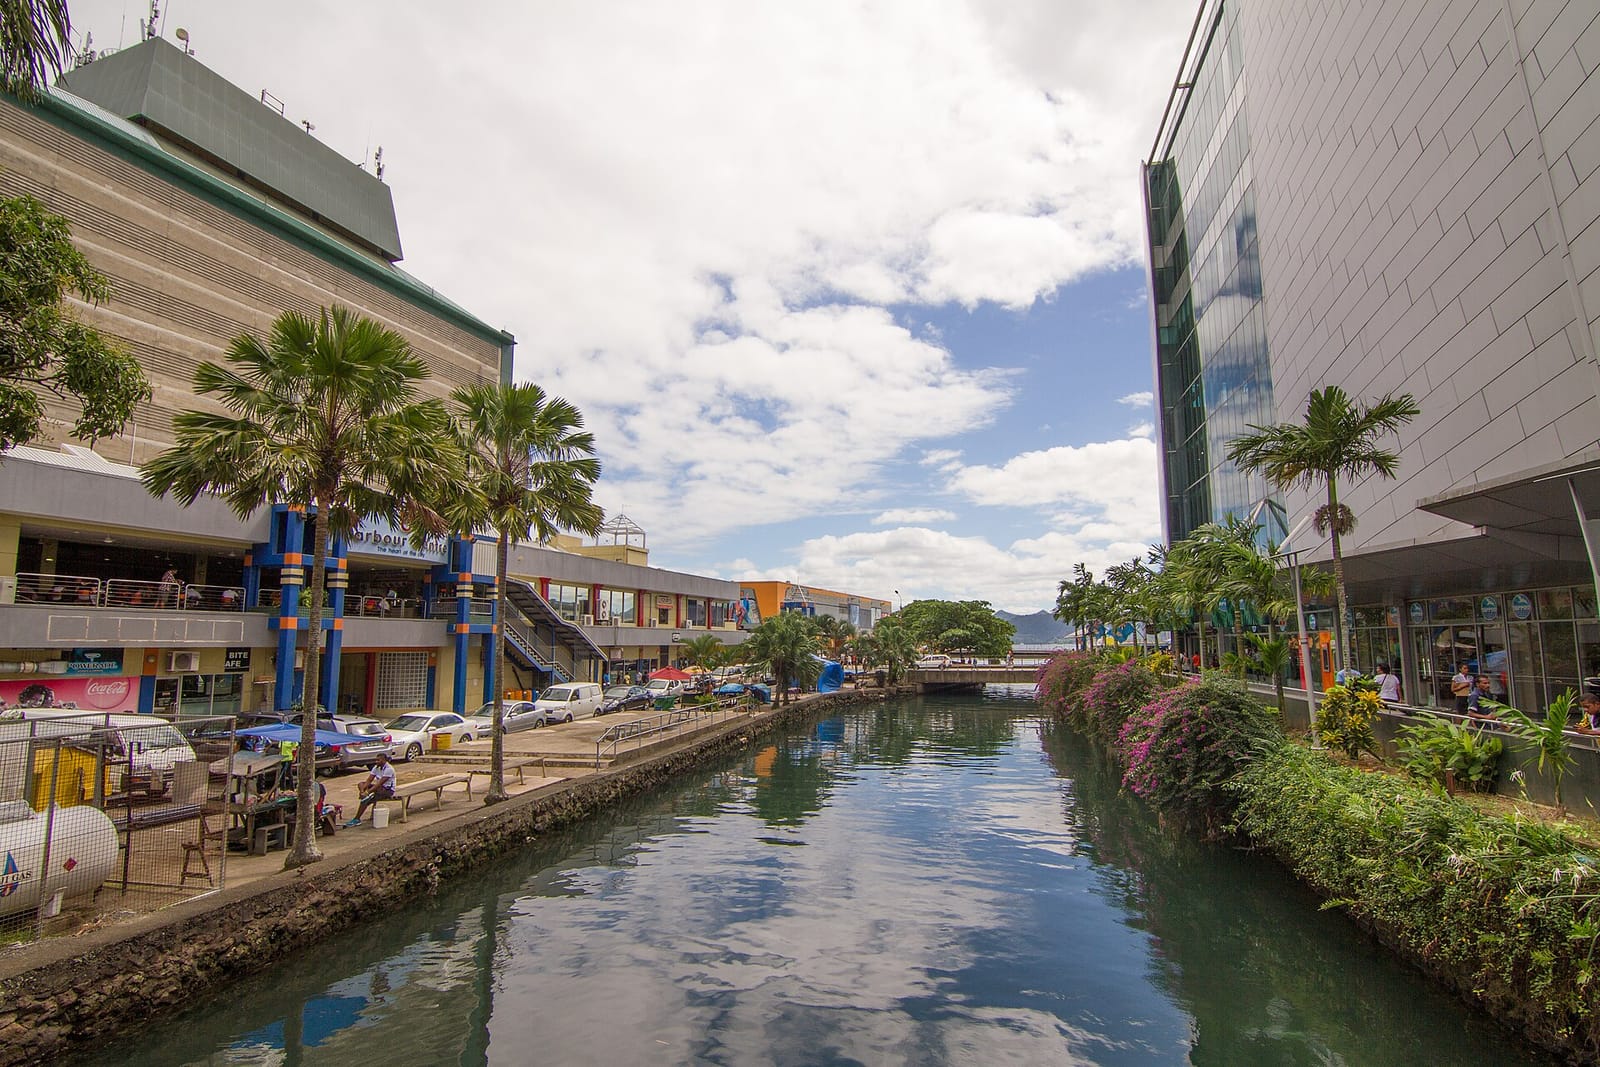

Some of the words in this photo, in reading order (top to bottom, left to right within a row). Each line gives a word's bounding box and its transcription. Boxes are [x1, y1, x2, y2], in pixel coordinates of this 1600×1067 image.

[351, 529, 407, 547] arbour
[228, 651, 249, 659] BITE
[12, 871, 32, 881] GAS
